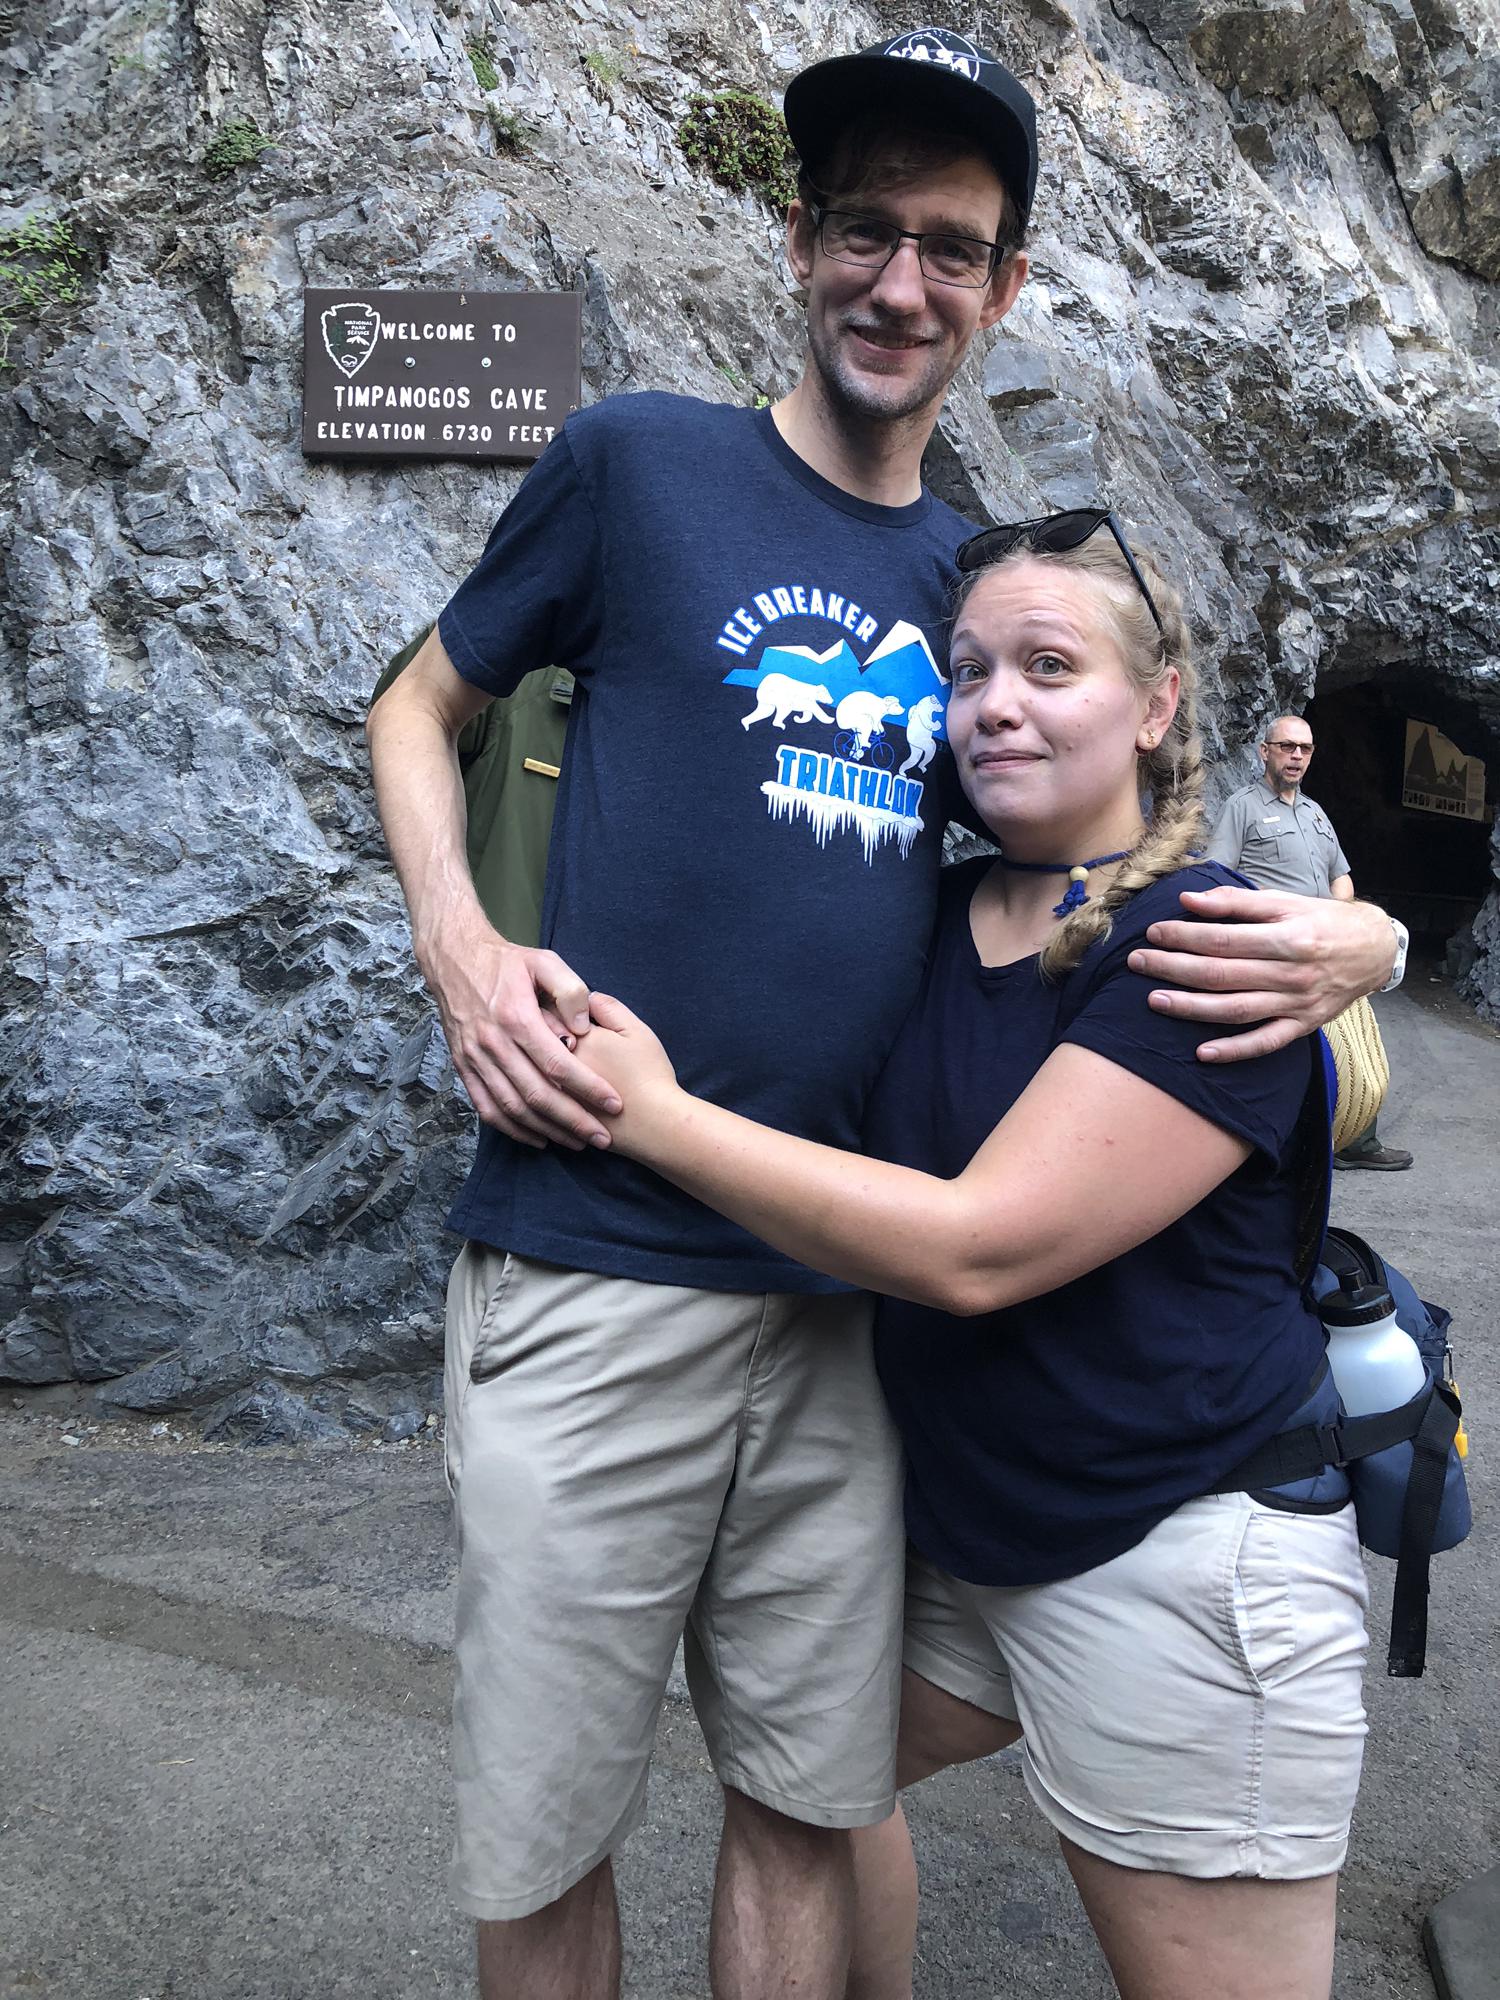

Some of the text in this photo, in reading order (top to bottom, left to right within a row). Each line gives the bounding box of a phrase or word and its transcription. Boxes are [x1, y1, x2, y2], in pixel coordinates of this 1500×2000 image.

[380, 322, 517, 343] WELCOME TO
[333, 385, 548, 411] TIMPANOGOS CAVE
[317, 421, 555, 443] ELEVATION 6730 FEET
[717, 585, 878, 656] ICE BREAKER
[777, 745, 923, 818] TRIATHLON
